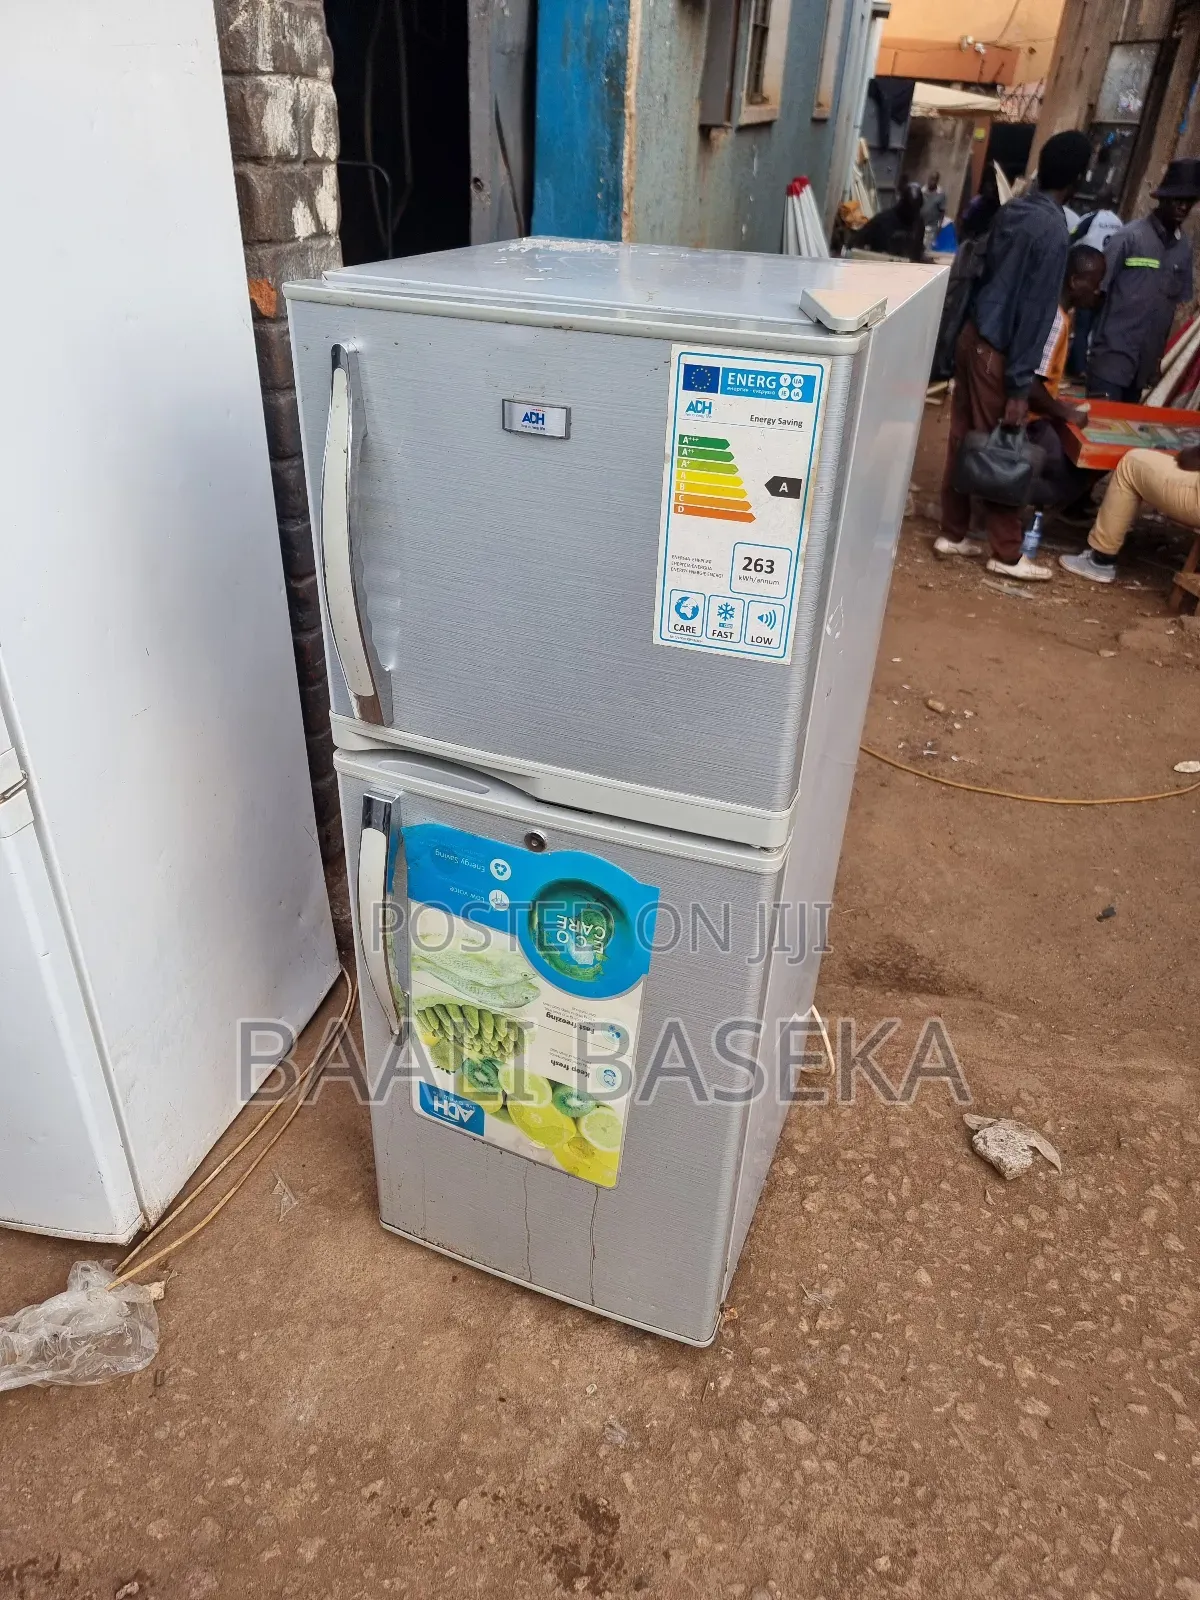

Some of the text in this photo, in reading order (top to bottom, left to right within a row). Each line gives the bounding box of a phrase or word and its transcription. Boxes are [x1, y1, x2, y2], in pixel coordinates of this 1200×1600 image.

[727, 372, 777, 389] ENERG
[685, 400, 713, 415] ADH
[521, 411, 545, 426] ADH
[749, 414, 803, 428] Energy Saving
[680, 471, 686, 479] A
[679, 483, 685, 491] B
[778, 482, 789, 493] A
[678, 494, 685, 502] C
[677, 505, 685, 513] D
[741, 556, 775, 575] 263
[738, 575, 780, 585] kWh/annum
[673, 623, 697, 634] CARE
[711, 629, 734, 640] FAST
[750, 635, 773, 646] LOW
[435, 848, 459, 864] Saving
[460, 857, 486, 873] Energy
[556, 914, 606, 940] CARE
[545, 1011, 578, 1029] freezing
[550, 1059, 570, 1072] fresh
[433, 1094, 476, 1124] ADH
